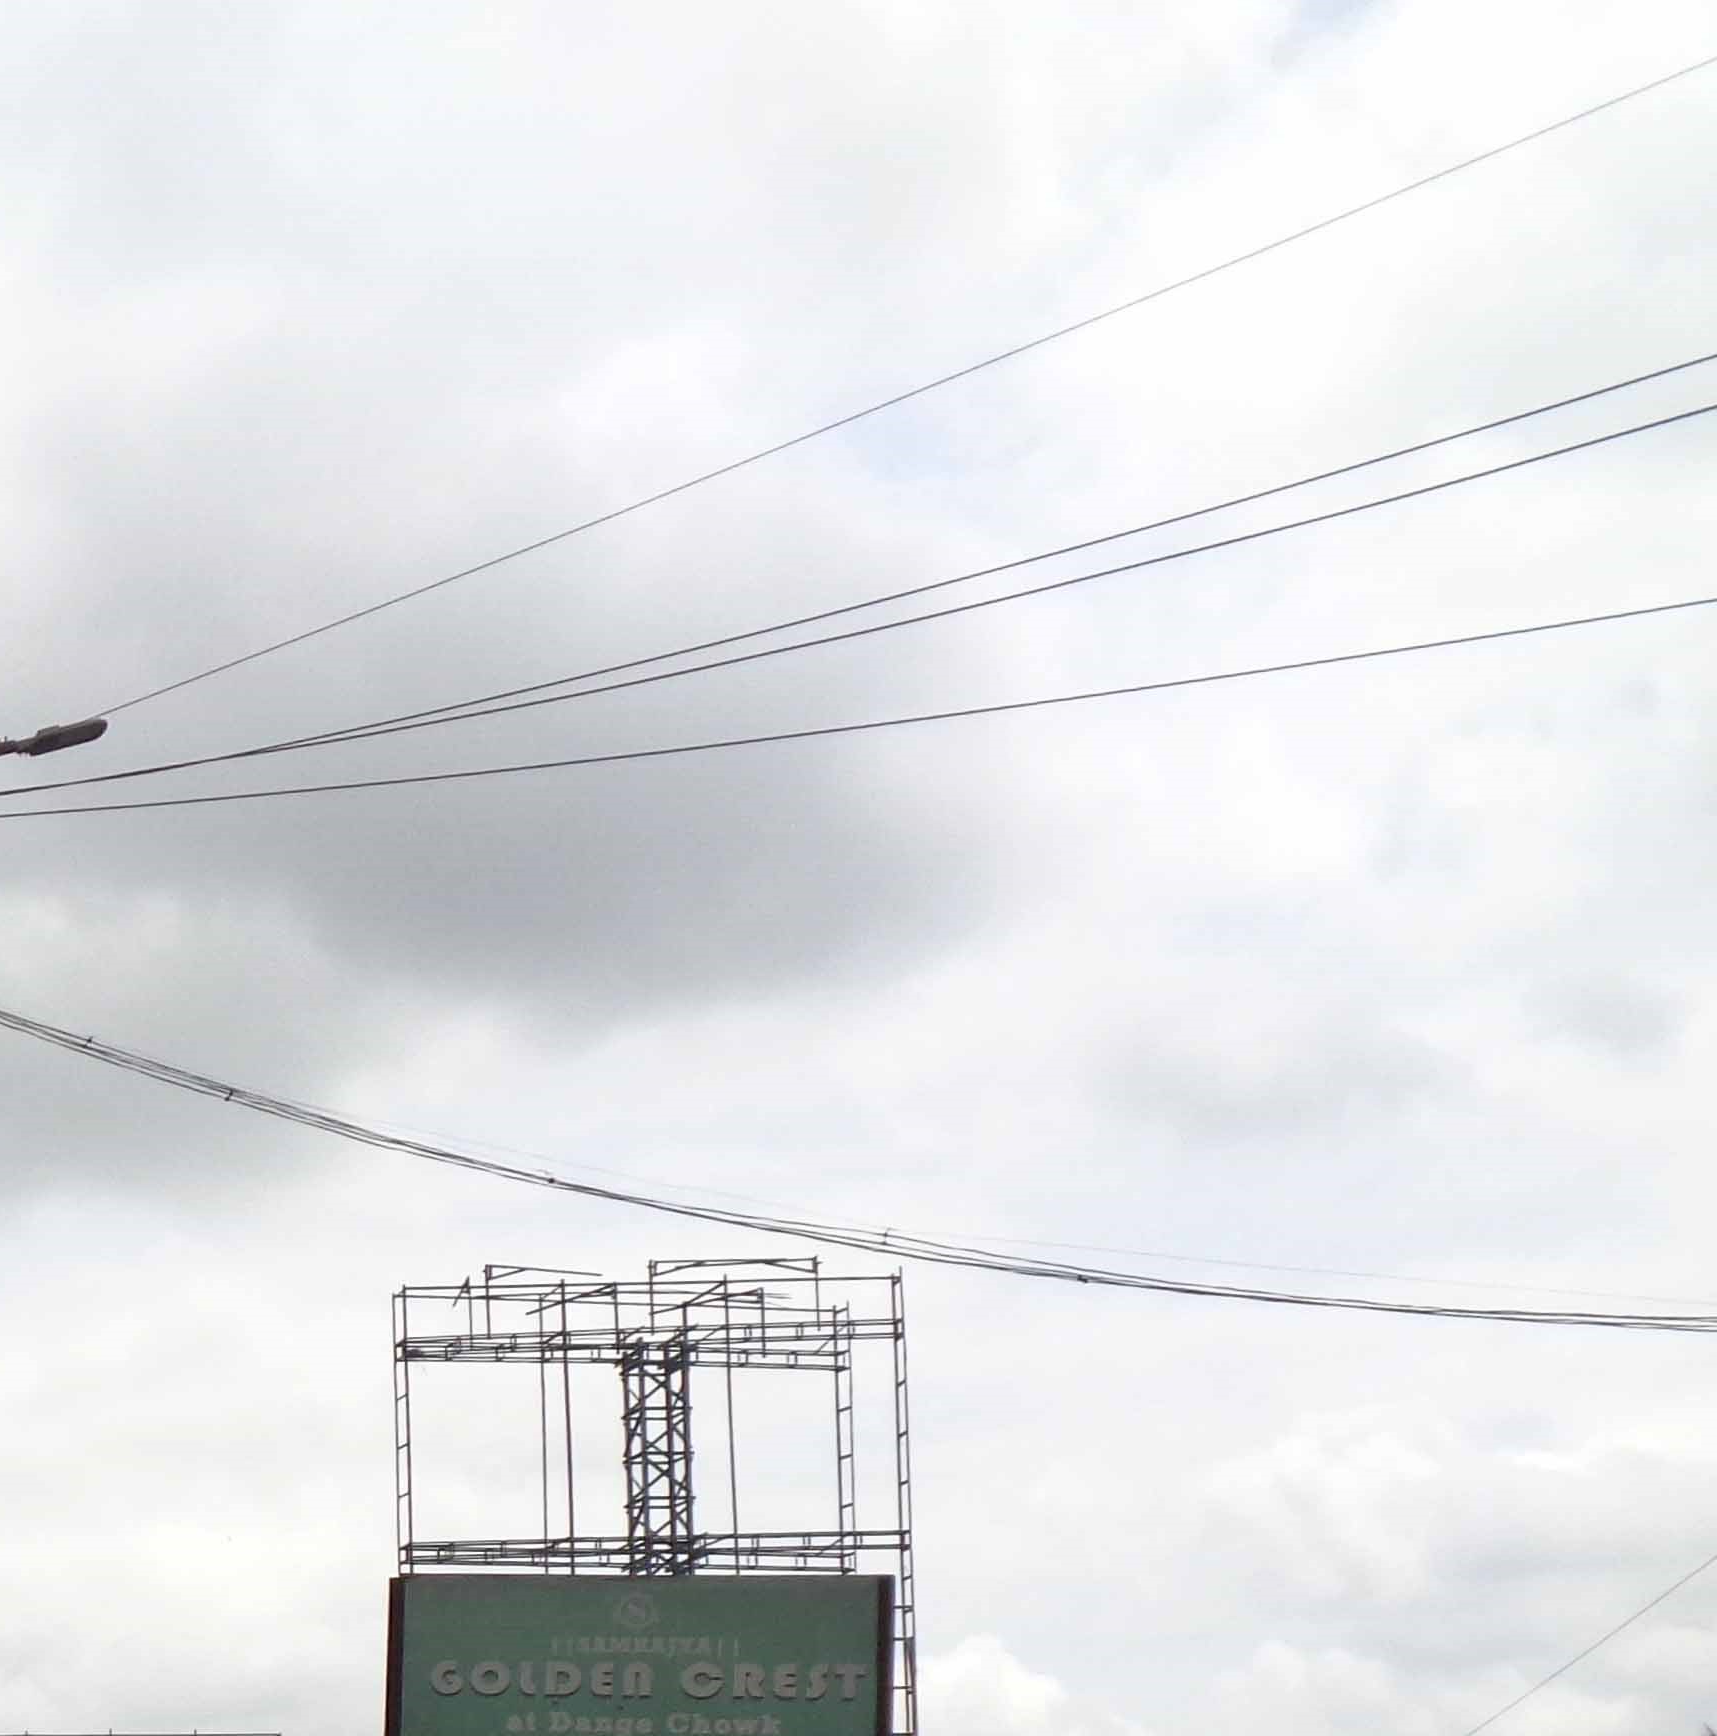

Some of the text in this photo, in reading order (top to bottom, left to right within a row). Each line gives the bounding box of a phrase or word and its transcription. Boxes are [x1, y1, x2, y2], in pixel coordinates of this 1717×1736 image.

[680, 1661, 867, 1701] CREST
[505, 1713, 536, 1734] at
[666, 1713, 783, 1736] Chowk
